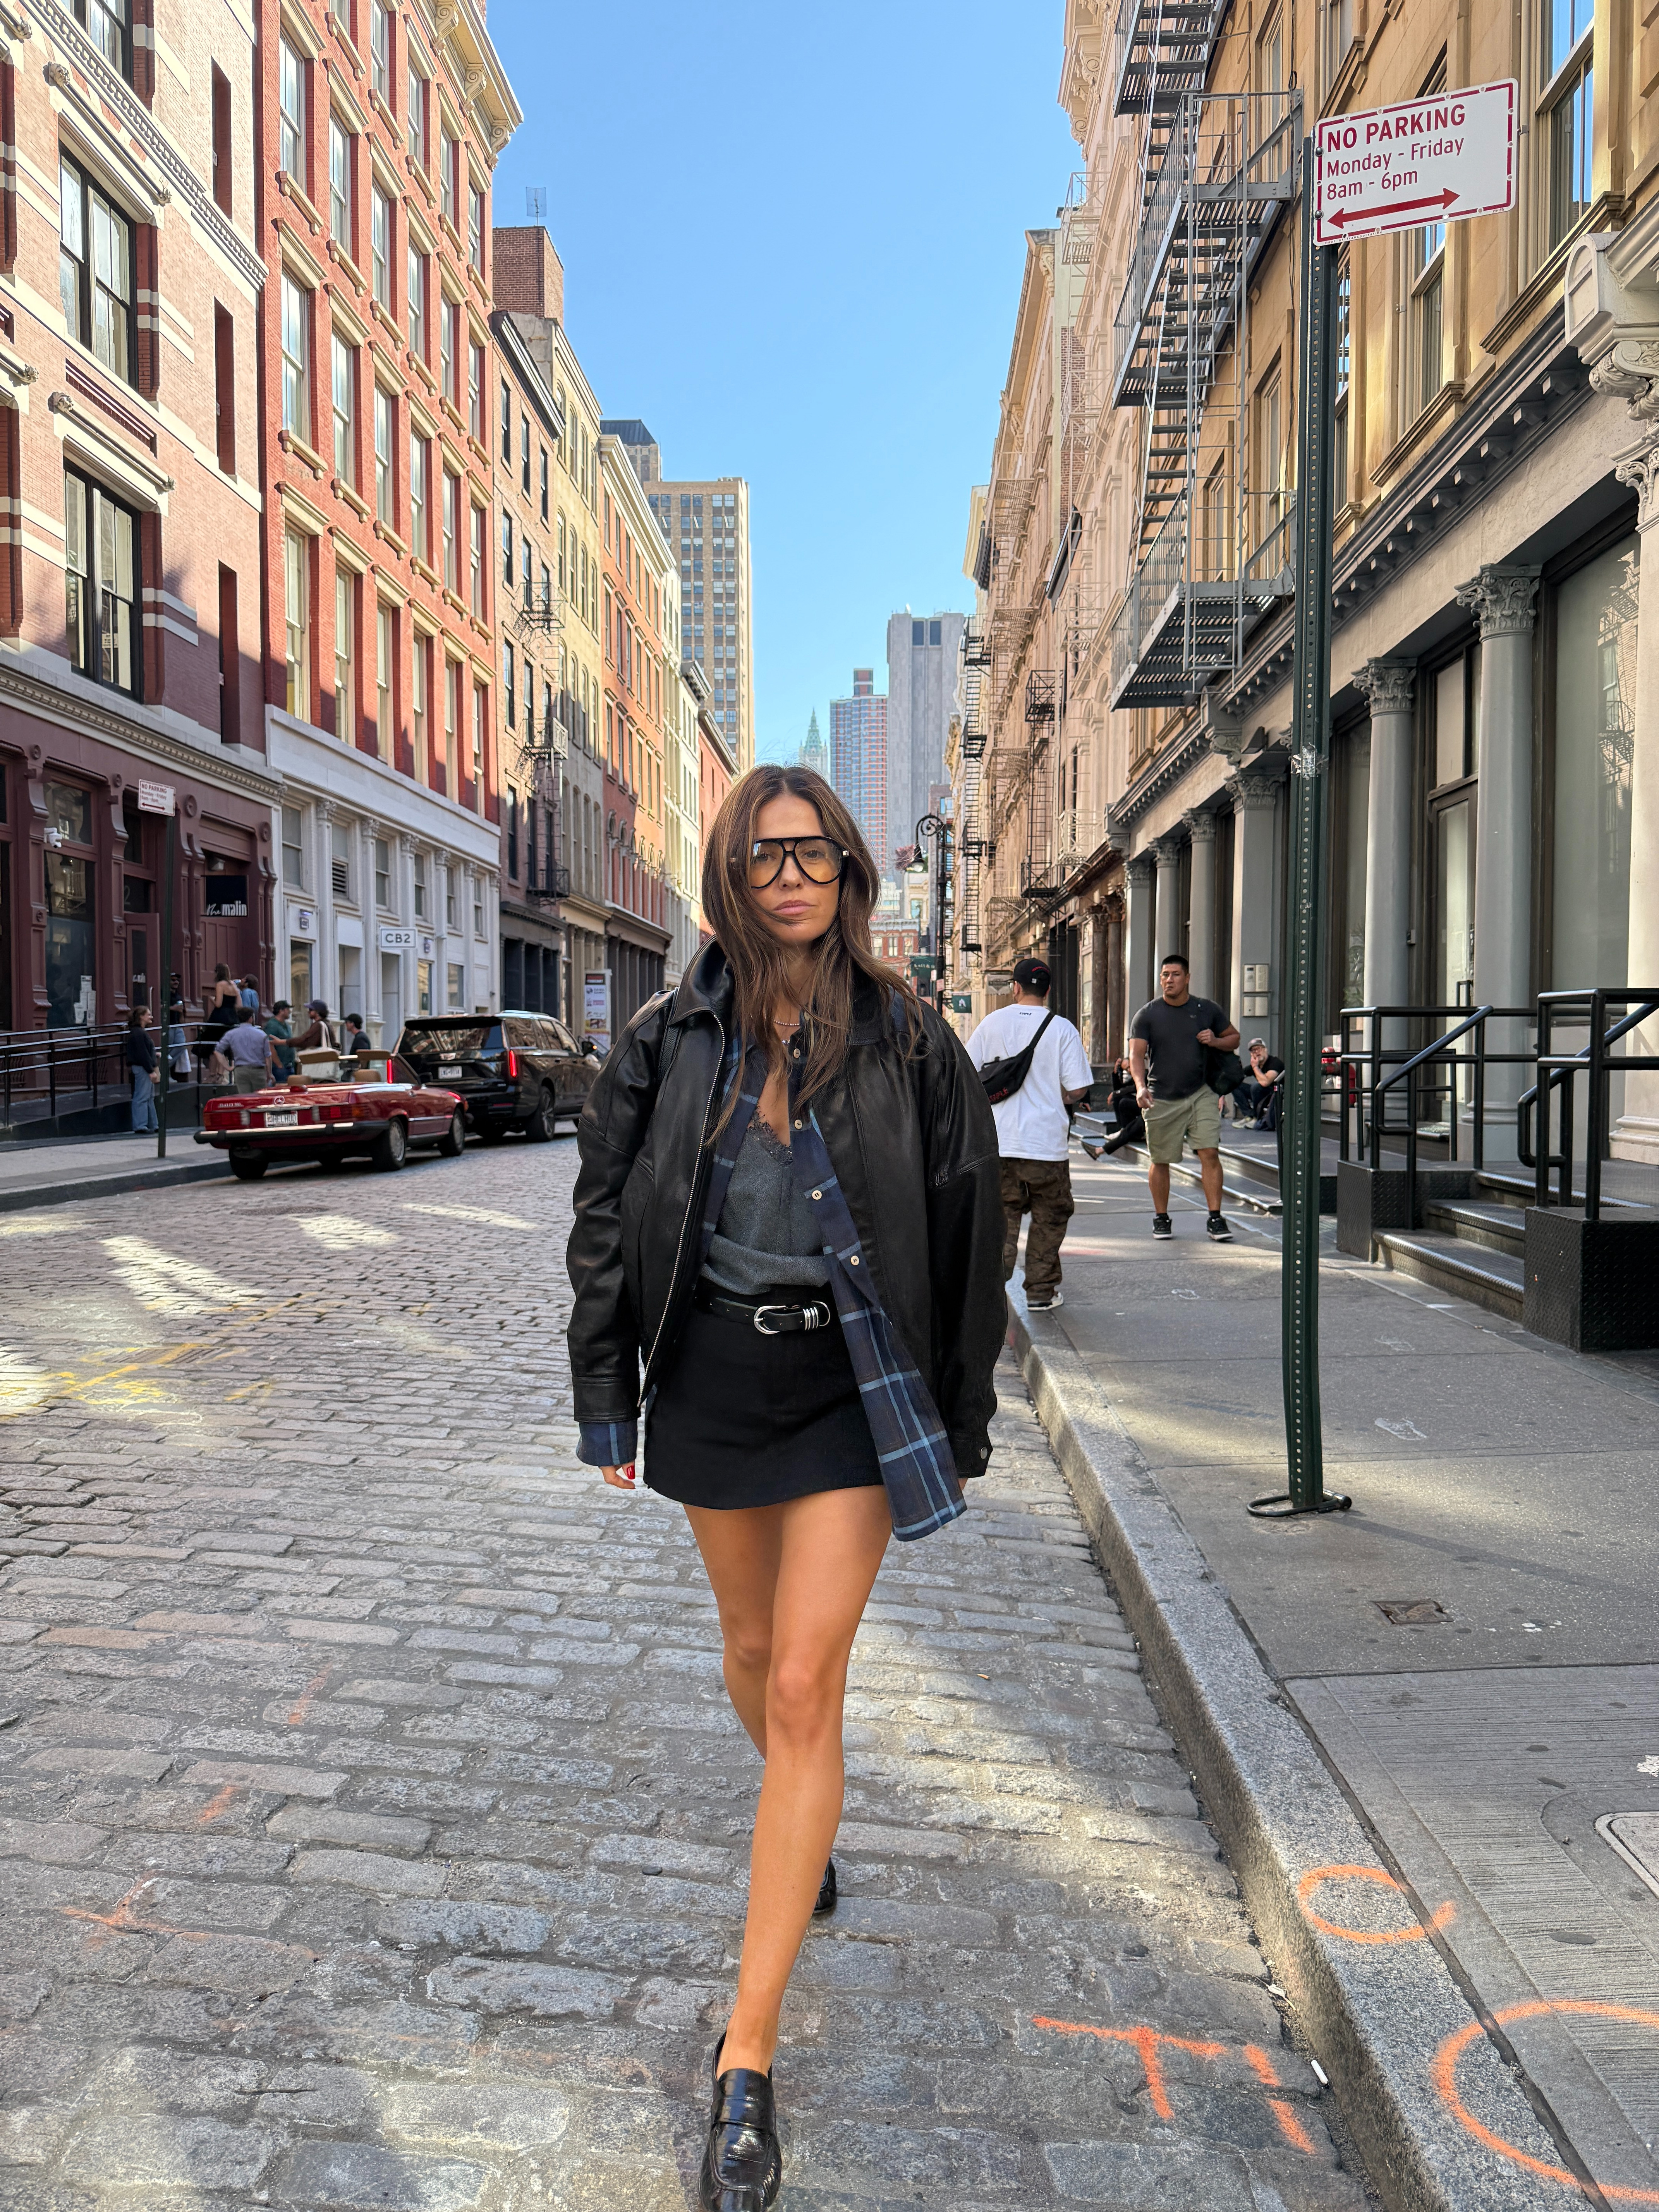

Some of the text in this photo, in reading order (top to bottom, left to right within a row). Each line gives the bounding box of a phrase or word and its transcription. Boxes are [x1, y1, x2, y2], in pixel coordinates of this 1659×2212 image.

[1328, 105, 1465, 153] NO PARKING
[1328, 153, 1392, 177] Monday
[1412, 138, 1464, 161] Friday
[1327, 182, 1362, 200] 8am
[1382, 171, 1417, 191] 6pm
[1346, 231, 1382, 240] Transportation
[149, 785, 167, 793] PARKING
[206, 900, 247, 916] the malin
[385, 933, 410, 943] CB2
